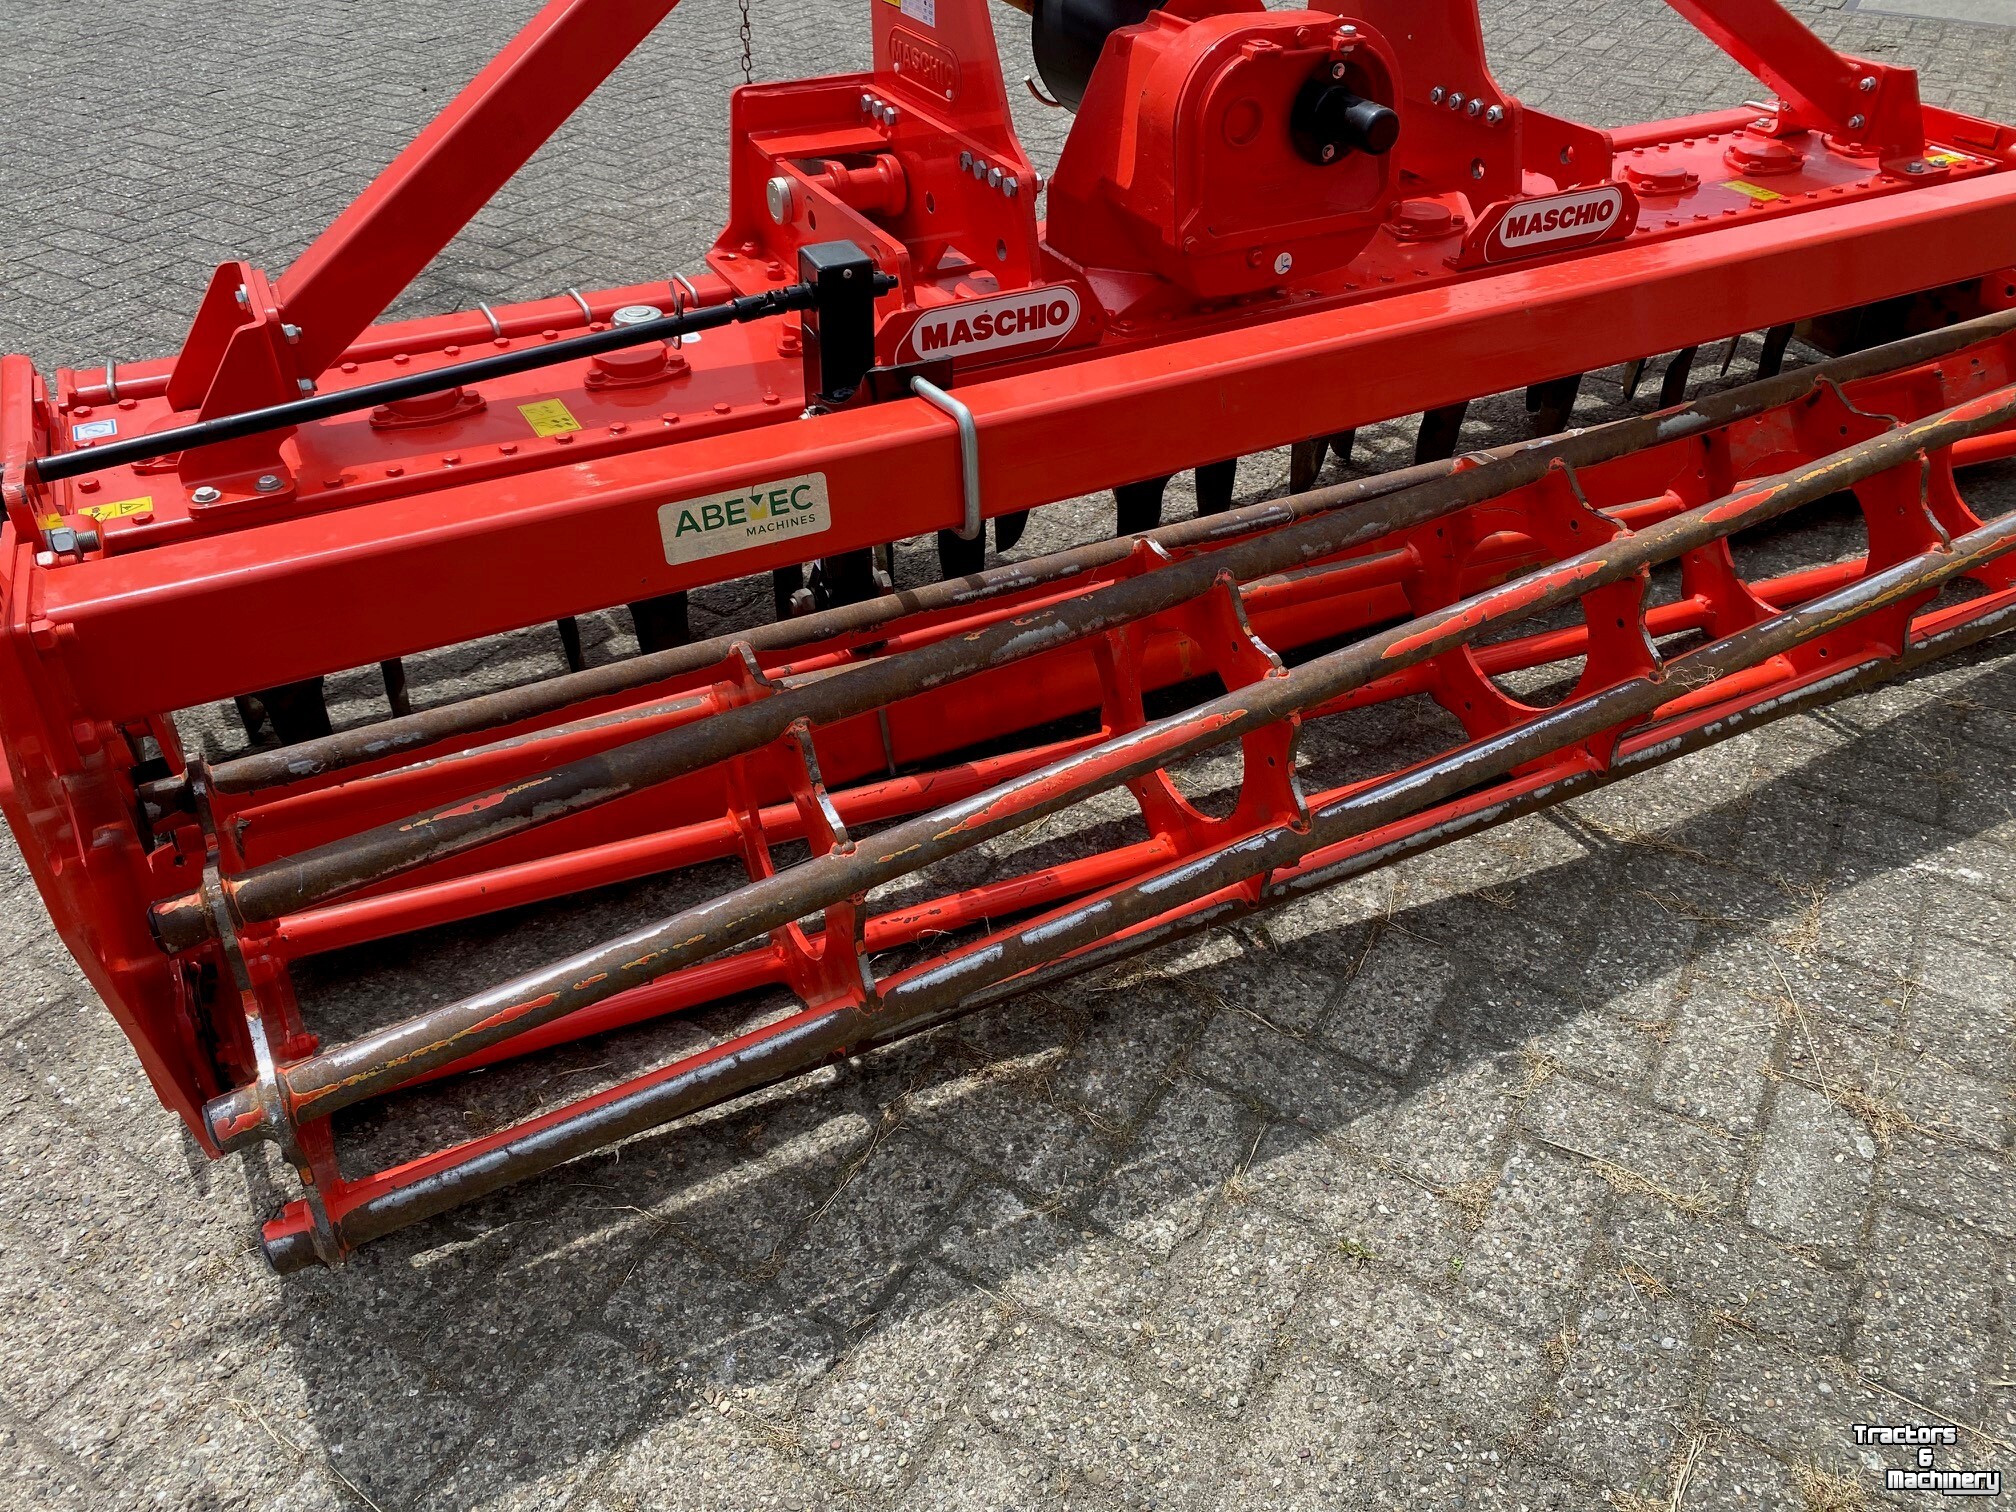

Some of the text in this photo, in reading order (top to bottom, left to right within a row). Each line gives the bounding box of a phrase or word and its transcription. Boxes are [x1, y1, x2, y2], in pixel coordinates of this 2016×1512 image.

[890, 37, 954, 87] MASCHIO
[1505, 199, 1614, 240] MASCHIO
[920, 299, 1070, 352] MASCHIO
[746, 513, 816, 537] MACHINES
